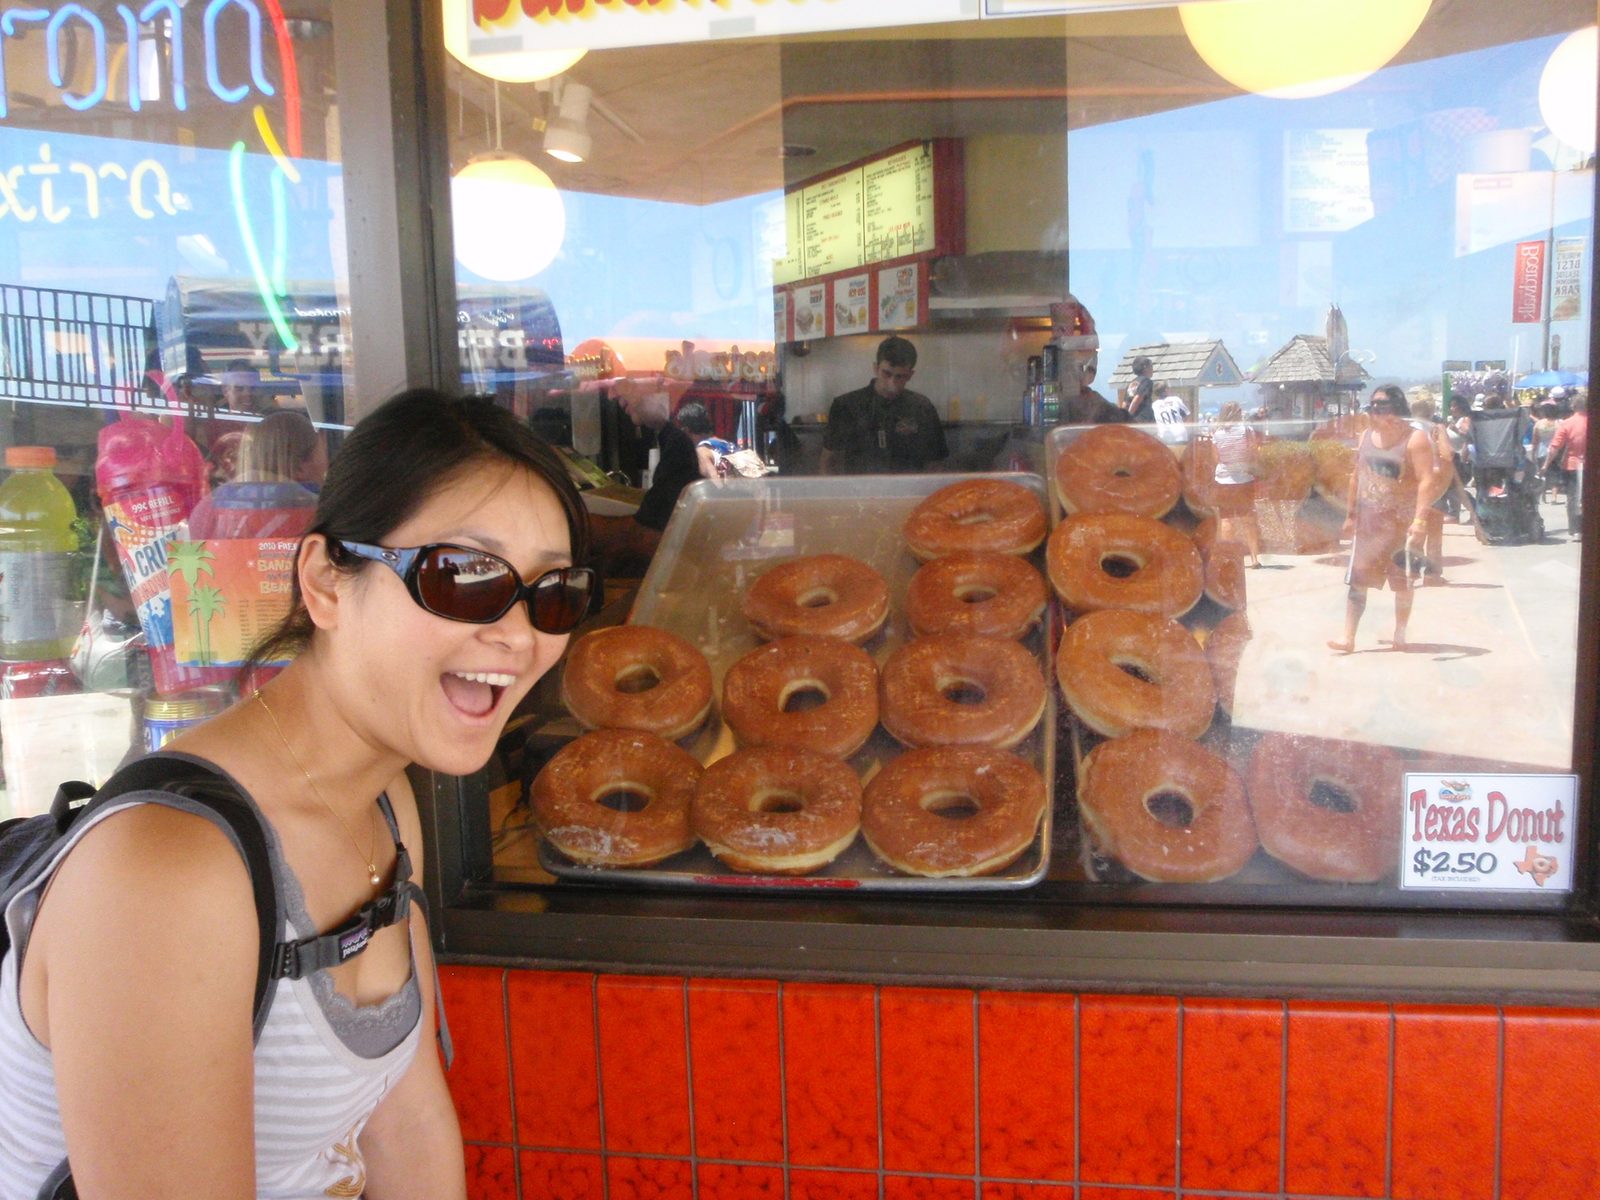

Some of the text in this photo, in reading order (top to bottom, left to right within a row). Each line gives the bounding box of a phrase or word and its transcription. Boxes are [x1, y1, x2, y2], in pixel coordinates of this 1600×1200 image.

[1410, 789, 1481, 843] Texas
[1485, 791, 1565, 843] Donut
[1413, 847, 1498, 877] $2.50
